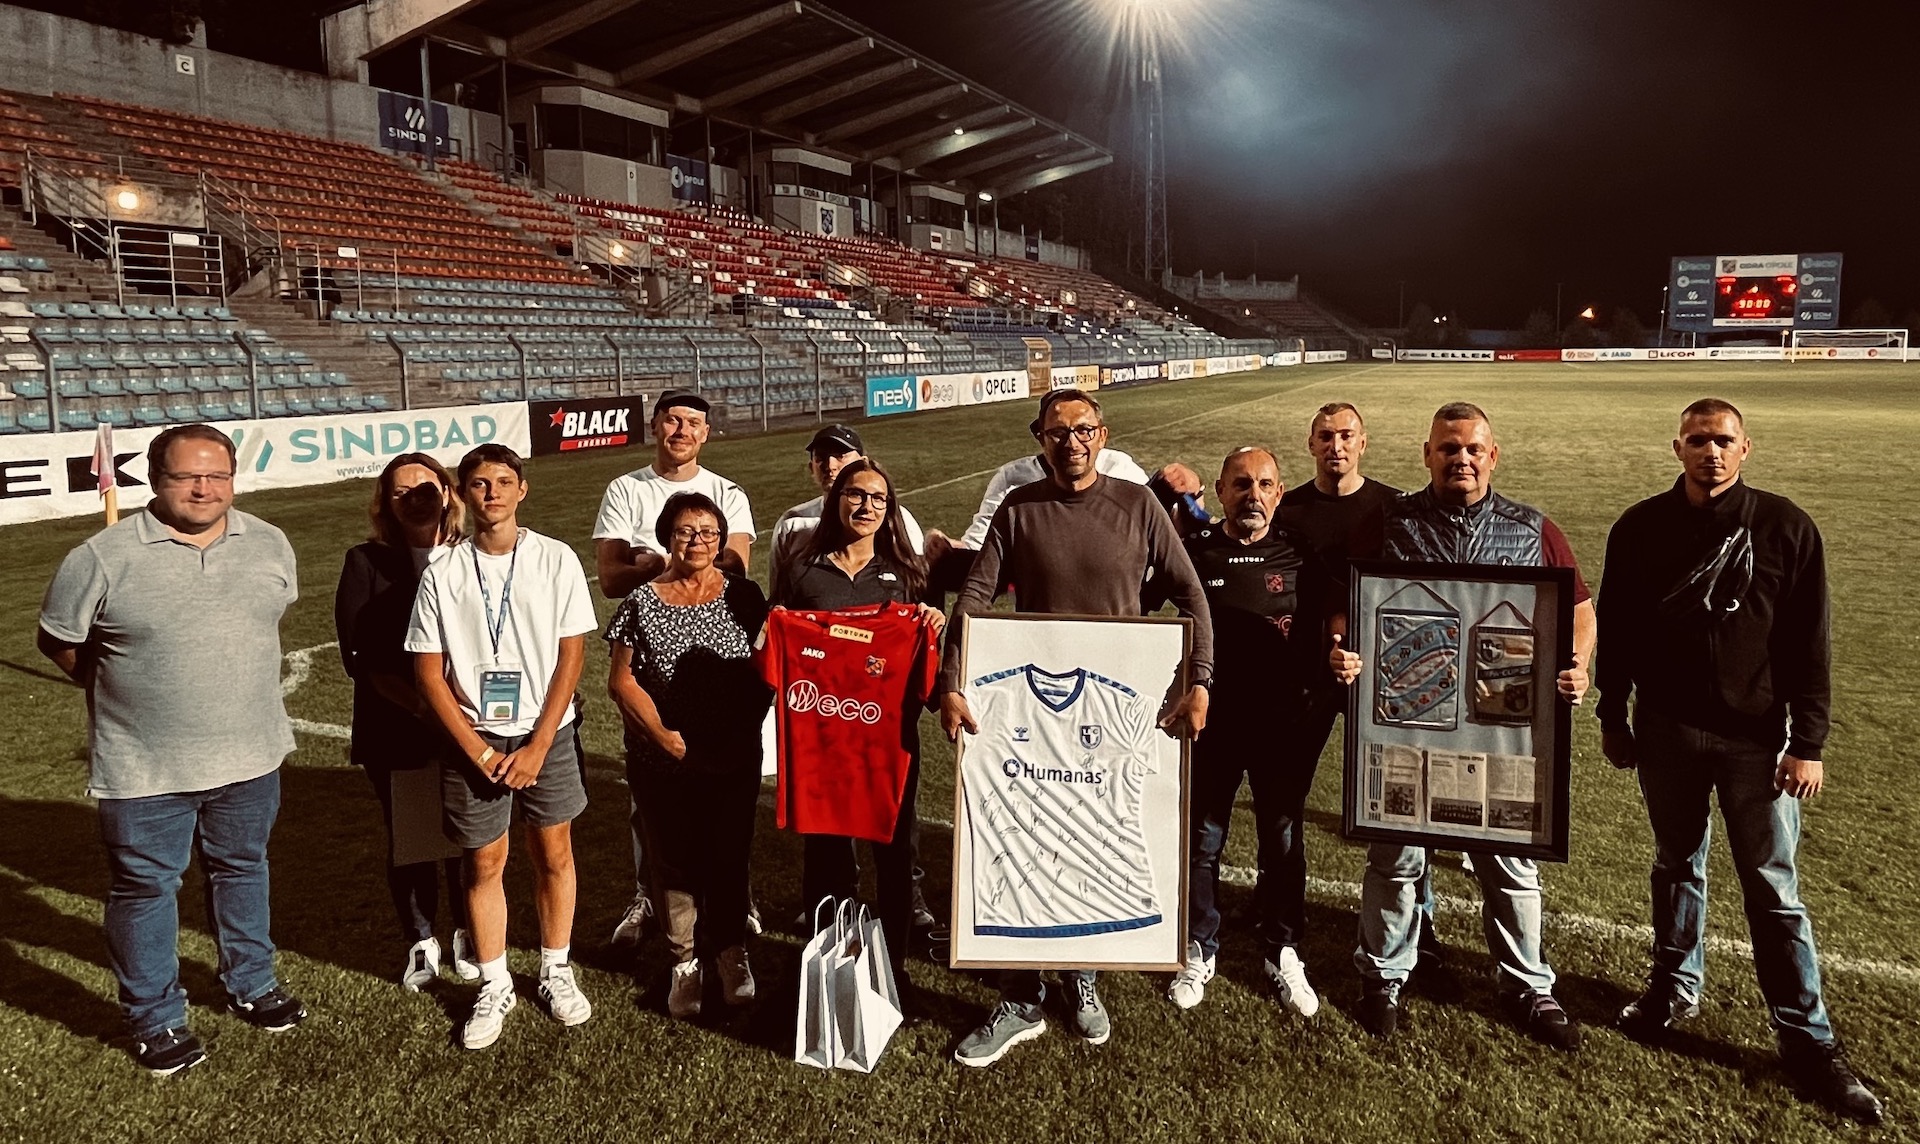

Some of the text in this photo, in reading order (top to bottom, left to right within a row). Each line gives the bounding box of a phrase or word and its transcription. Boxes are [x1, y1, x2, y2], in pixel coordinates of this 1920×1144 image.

[181, 61, 189, 71] C
[388, 126, 442, 146] SINDBD
[684, 175, 704, 186] OPOLE
[1738, 299, 1771, 309] 90:00
[1660, 350, 1695, 358] LICON
[986, 378, 1016, 395] OPOLE
[562, 408, 630, 438] BLACK
[289, 414, 497, 463] SINDBAD
[833, 627, 869, 639] FORTUNA
[801, 647, 826, 659] JAKO
[817, 694, 882, 725] eco
[1023, 762, 1102, 784] Humanas
